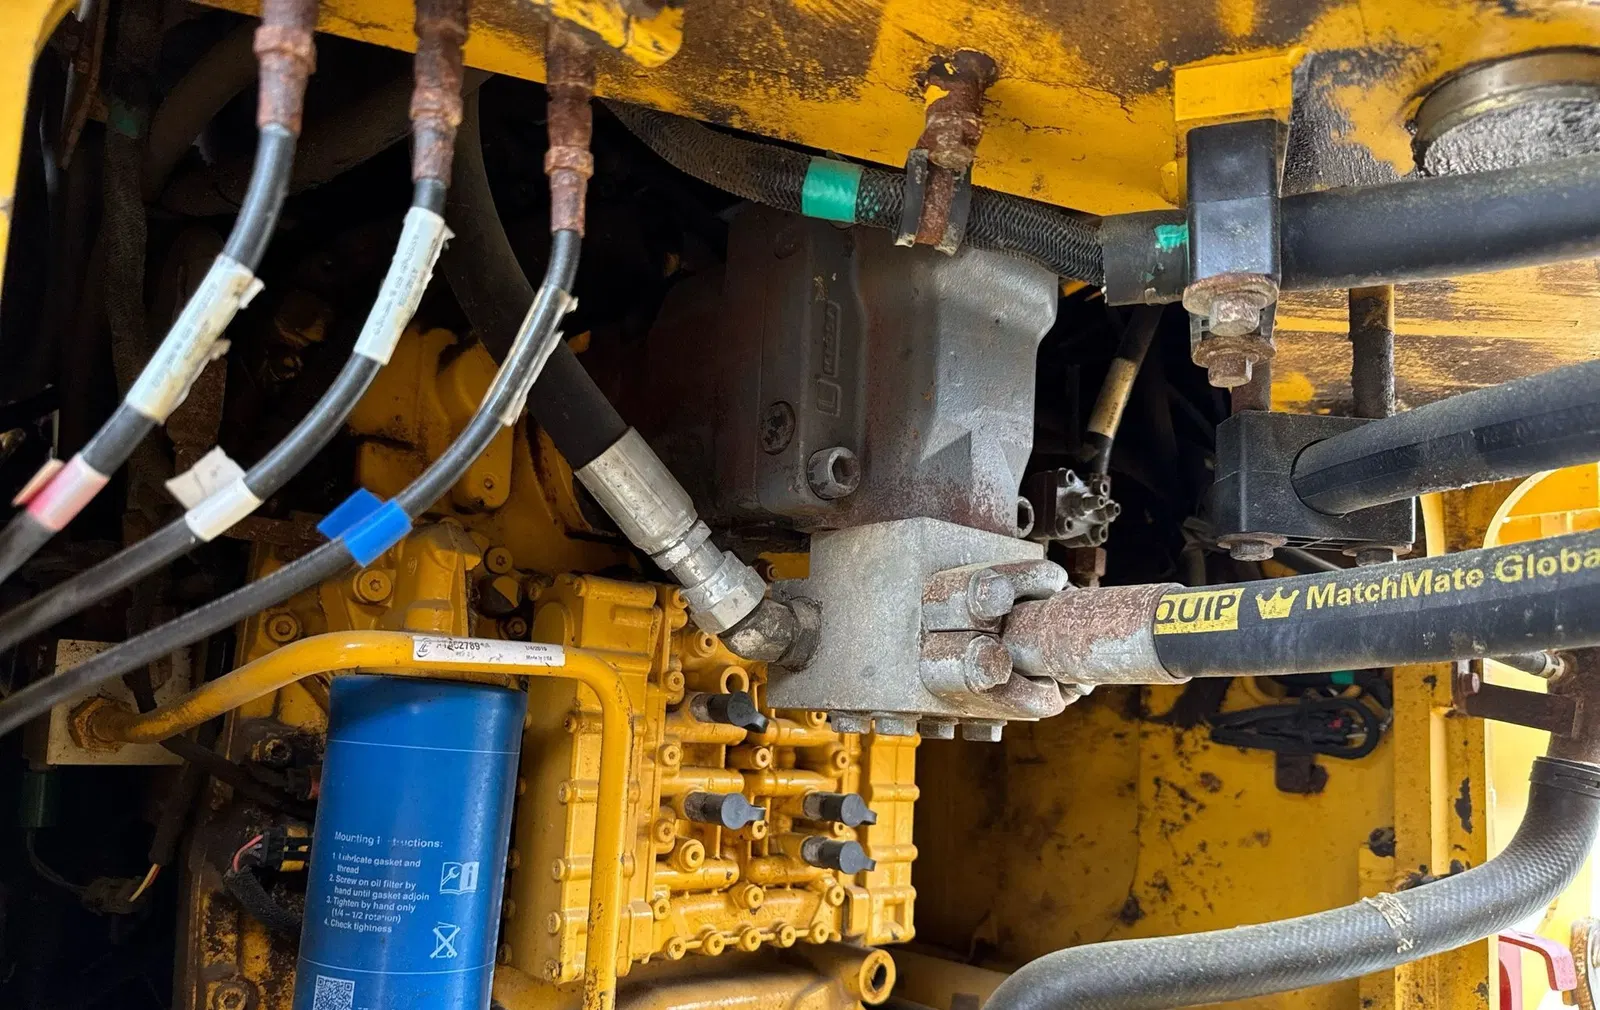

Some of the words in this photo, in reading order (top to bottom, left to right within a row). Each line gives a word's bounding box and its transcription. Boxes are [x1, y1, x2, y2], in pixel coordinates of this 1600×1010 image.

[1306, 568, 1485, 611] MatchMate
[337, 864, 360, 874] thread
[373, 858, 403, 866] gasket
[404, 859, 421, 868] and
[335, 874, 357, 885] Screw
[370, 879, 382, 888] oil
[383, 879, 404, 889] filter
[405, 881, 417, 891] by
[334, 886, 352, 895] hand
[353, 889, 371, 897] until
[372, 890, 401, 900] gasket
[402, 892, 430, 902] adjoin
[333, 896, 359, 907] Tighten
[361, 901, 371, 910] by
[373, 902, 395, 911] hand
[396, 903, 417, 913] only
[352, 911, 364, 919] 1/2
[330, 919, 352, 929] Check
[353, 921, 393, 933] tightness
